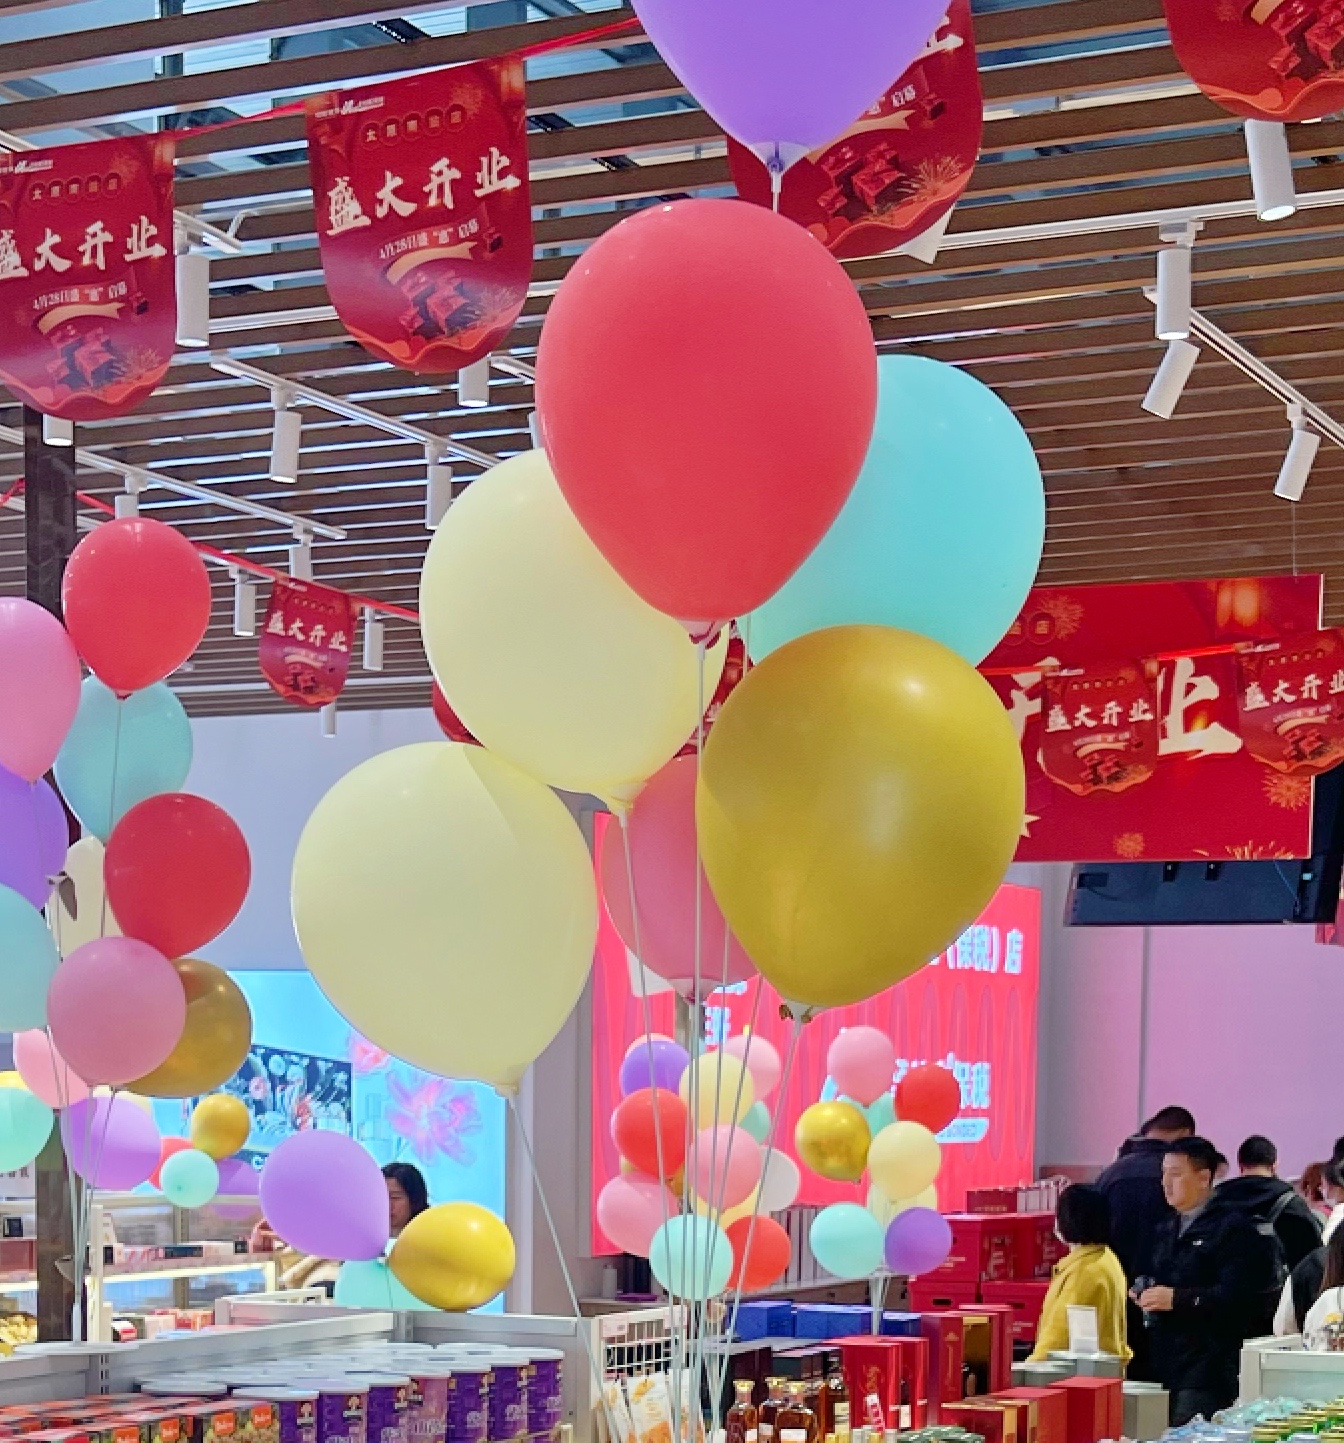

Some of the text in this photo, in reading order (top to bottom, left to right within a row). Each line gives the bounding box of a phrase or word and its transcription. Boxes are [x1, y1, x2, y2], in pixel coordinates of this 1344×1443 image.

[327, 147, 521, 235] 盛大开业
[265, 609, 348, 652] 盛大开业
[1045, 697, 1154, 734] 盛大开业
